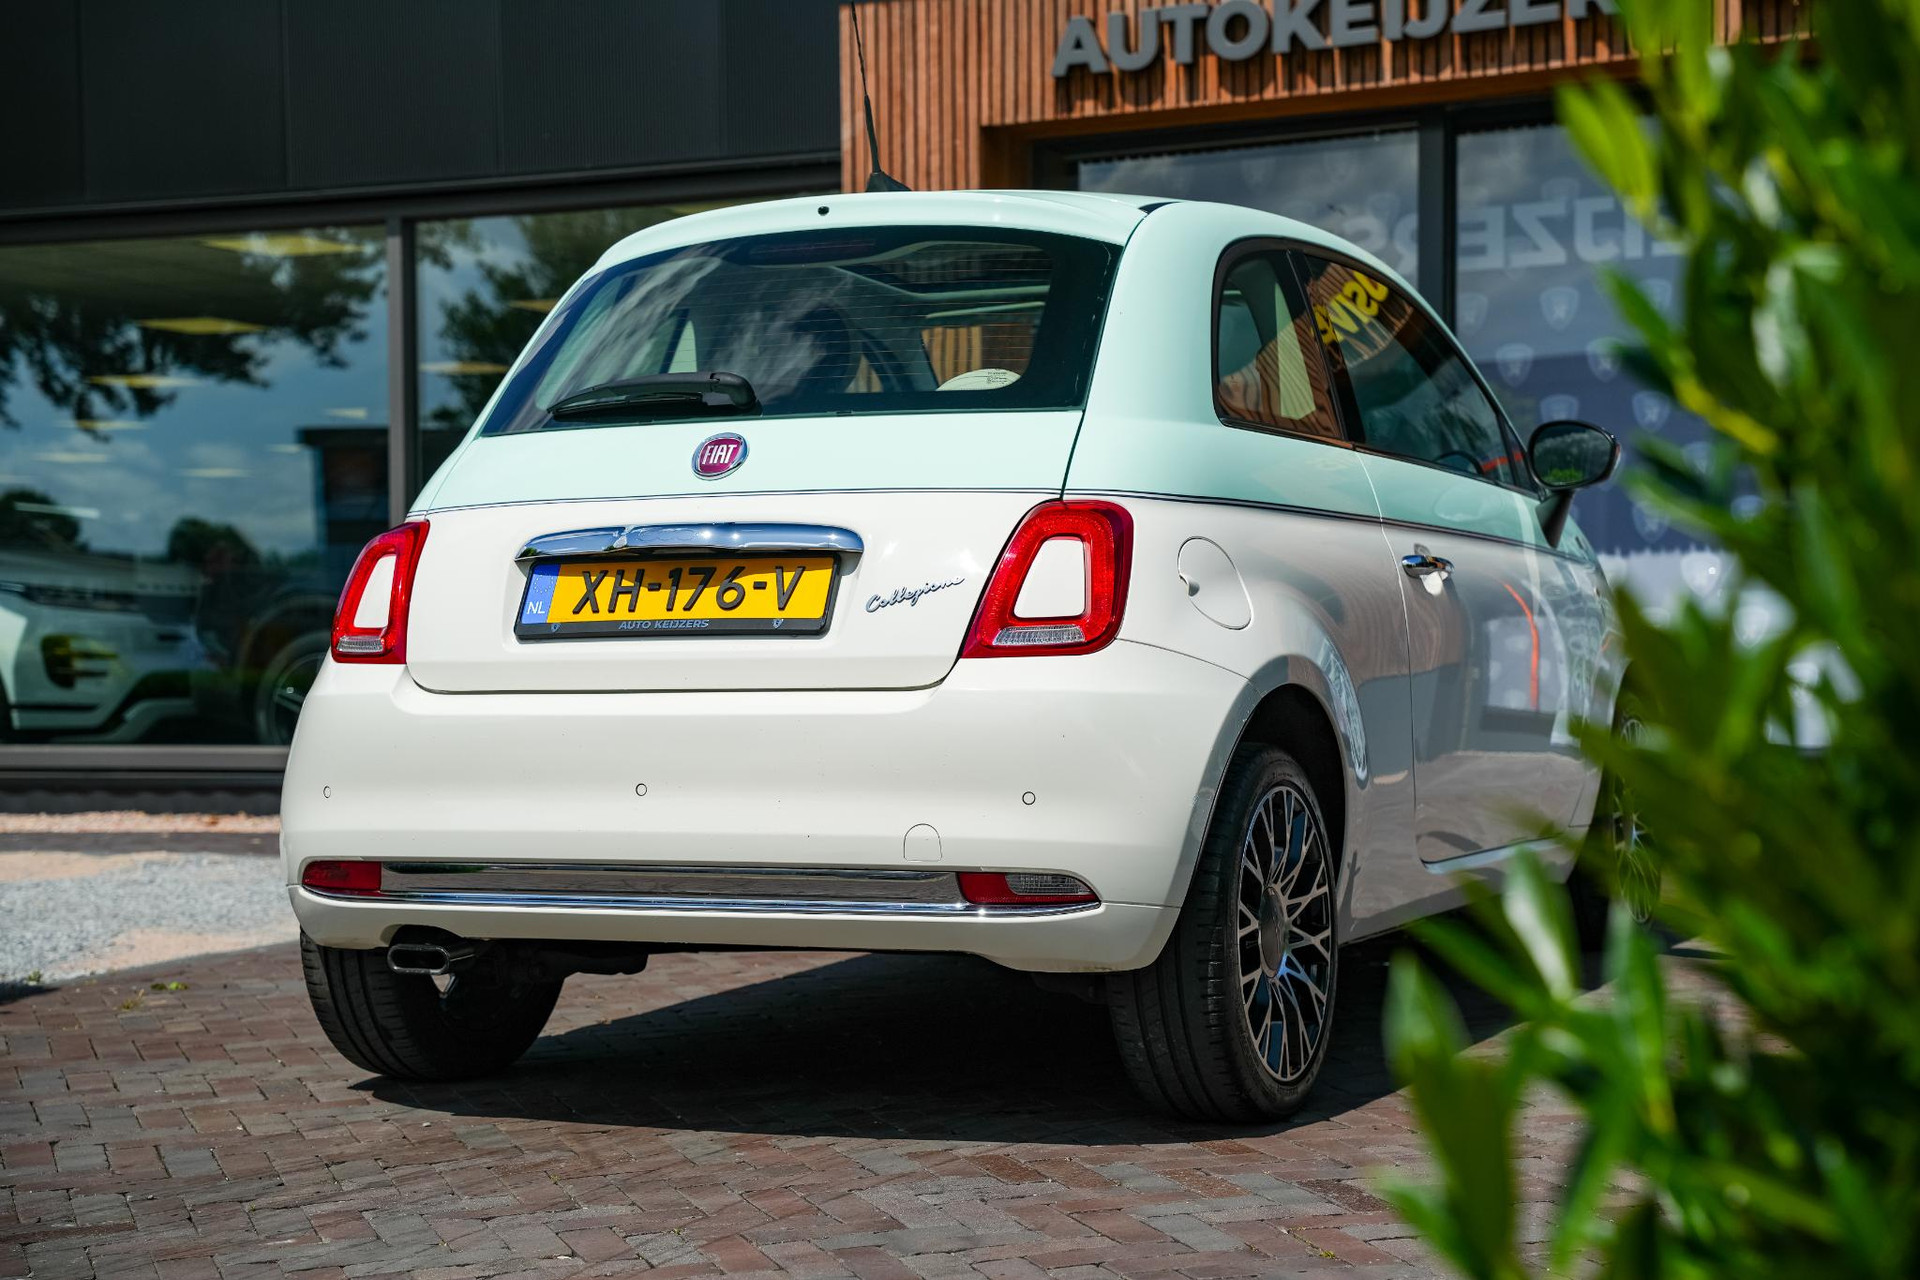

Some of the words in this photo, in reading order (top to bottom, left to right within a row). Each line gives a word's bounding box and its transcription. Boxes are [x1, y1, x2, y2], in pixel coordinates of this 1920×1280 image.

[1053, 0, 1619, 77] AUTOKEIJZ
[702, 444, 738, 465] FIAT
[572, 566, 806, 615] XH-176-V
[866, 577, 965, 613] Collezione
[527, 601, 546, 614] NL
[618, 620, 651, 630] AUTO
[654, 619, 710, 629] KEIJZERS
